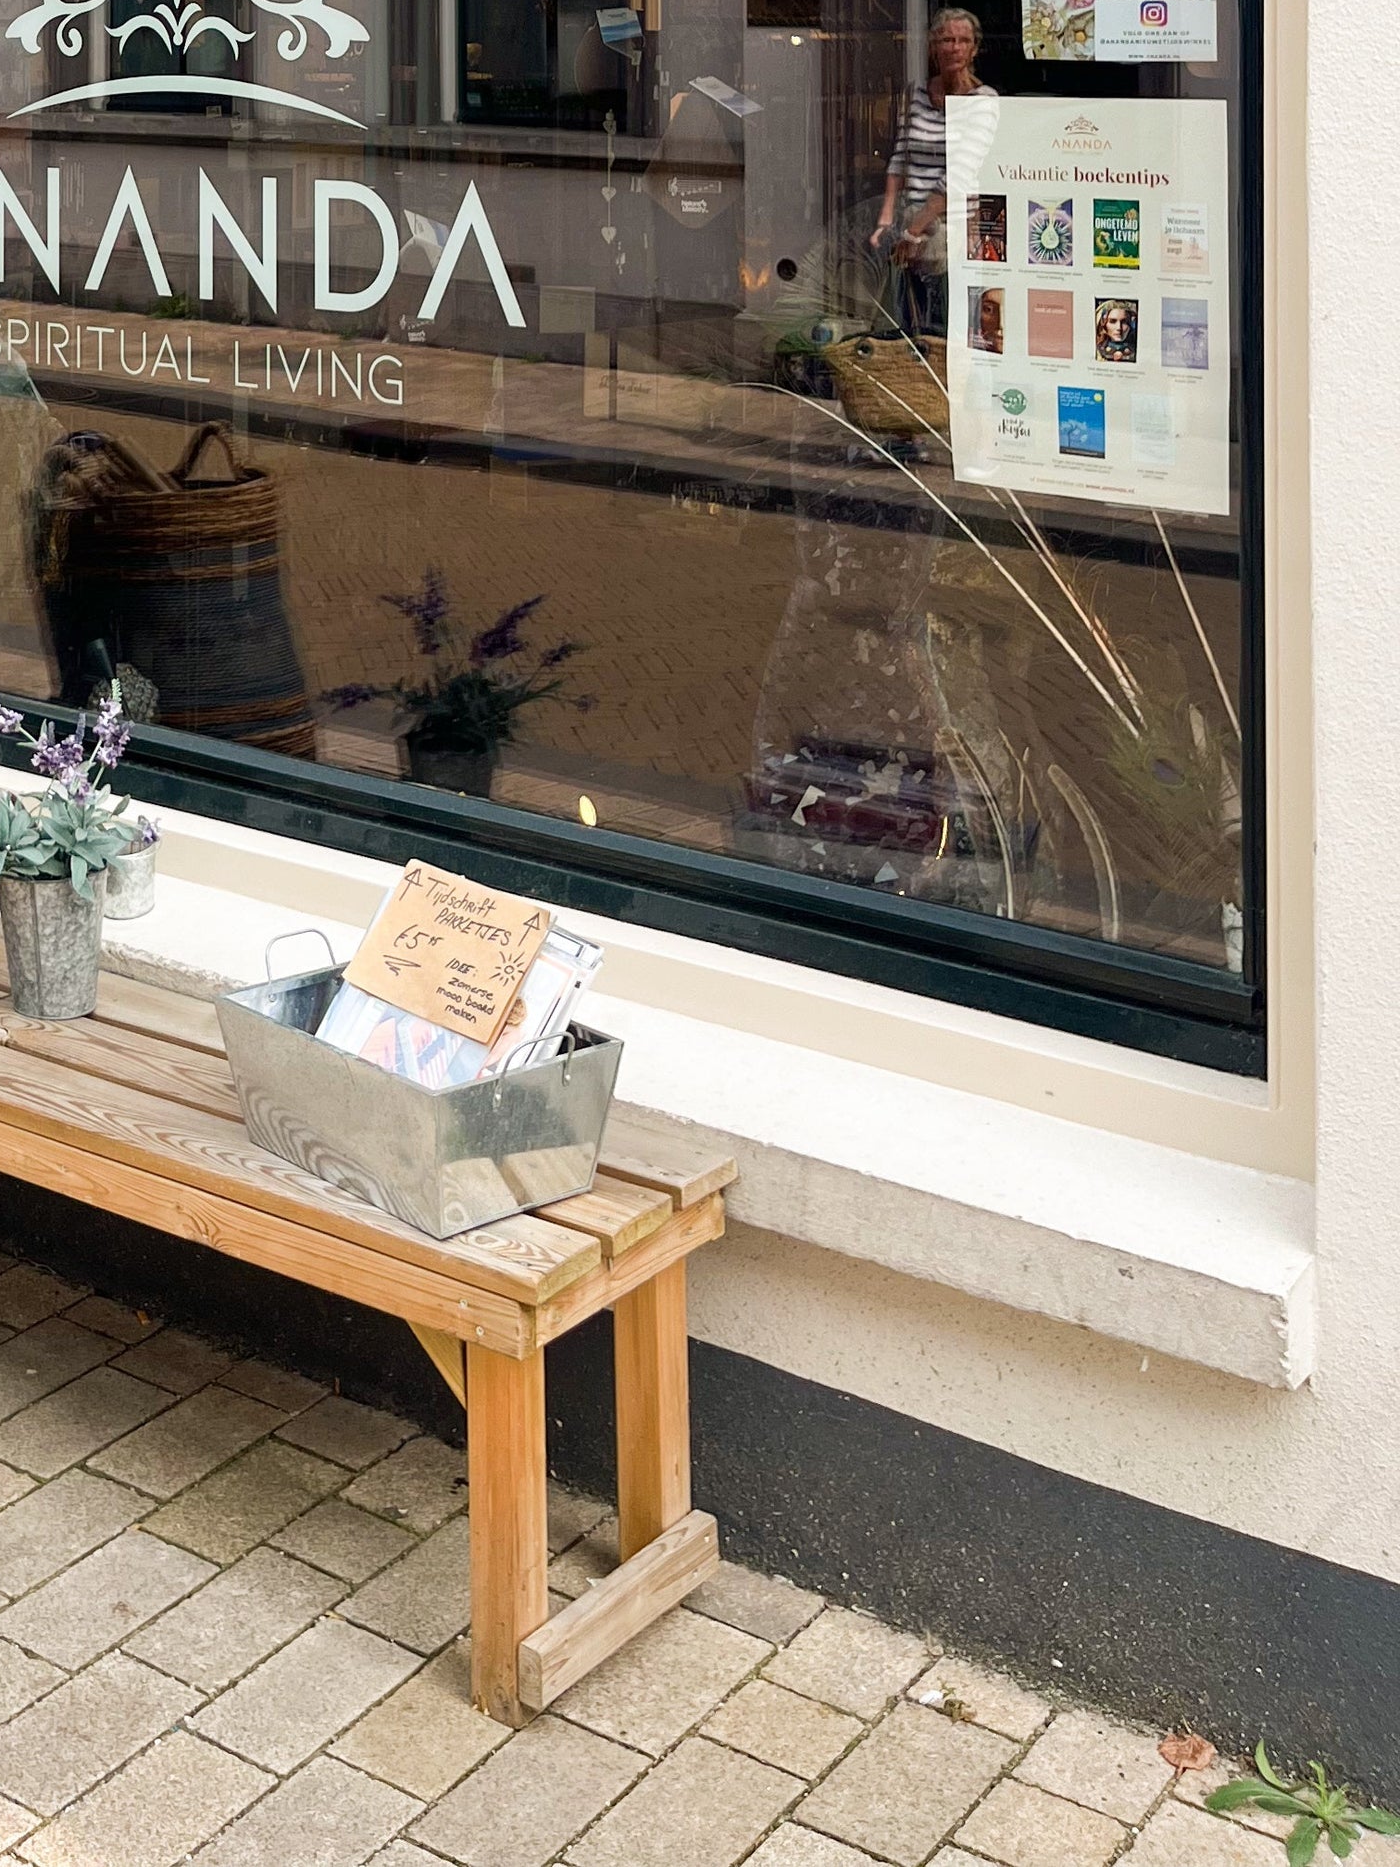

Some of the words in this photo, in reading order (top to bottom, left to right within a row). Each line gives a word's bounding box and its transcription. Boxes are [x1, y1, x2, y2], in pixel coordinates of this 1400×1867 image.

[1051, 138, 1113, 150] ANANDA
[997, 164, 1069, 182] Vakantie
[1074, 166, 1170, 188] boekentips
[1113, 230, 1138, 243] LEVEN
[233, 344, 404, 406] LIVING
[444, 1004, 477, 1024] maken
